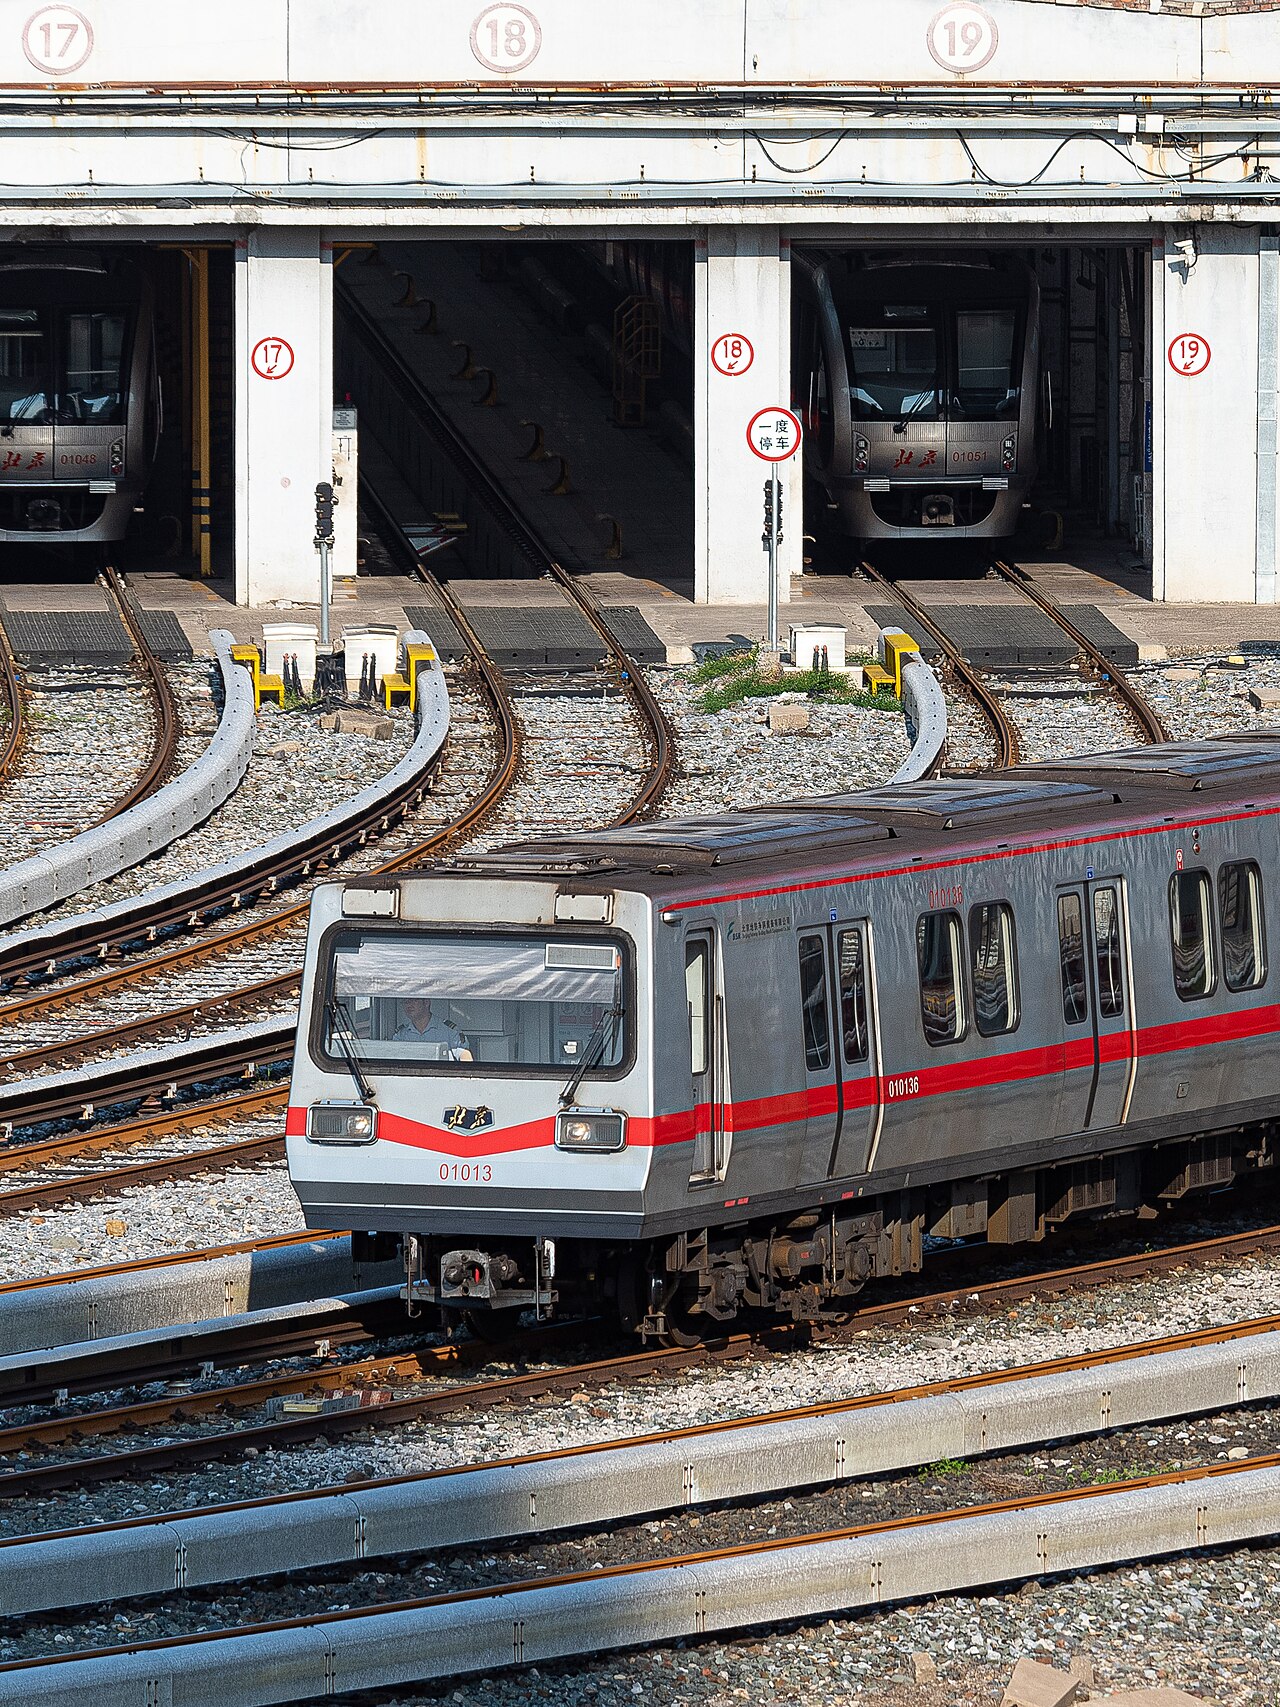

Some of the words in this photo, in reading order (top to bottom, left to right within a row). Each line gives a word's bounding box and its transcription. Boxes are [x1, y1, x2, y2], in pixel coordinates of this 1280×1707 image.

[39, 23, 78, 58] 17
[487, 20, 526, 56] 18
[942, 21, 981, 56] 19
[263, 344, 283, 363] 17
[723, 340, 743, 358] 18
[1180, 340, 1199, 359] 19
[758, 419, 789, 433] 一度
[759, 436, 790, 451] 停车
[60, 454, 97, 465] 01048
[893, 449, 939, 469] 北京
[952, 451, 988, 463] 01051
[928, 885, 963, 909] 010136
[888, 1076, 919, 1098] 010136
[447, 1104, 491, 1130] 北京
[439, 1163, 492, 1182] 01013
